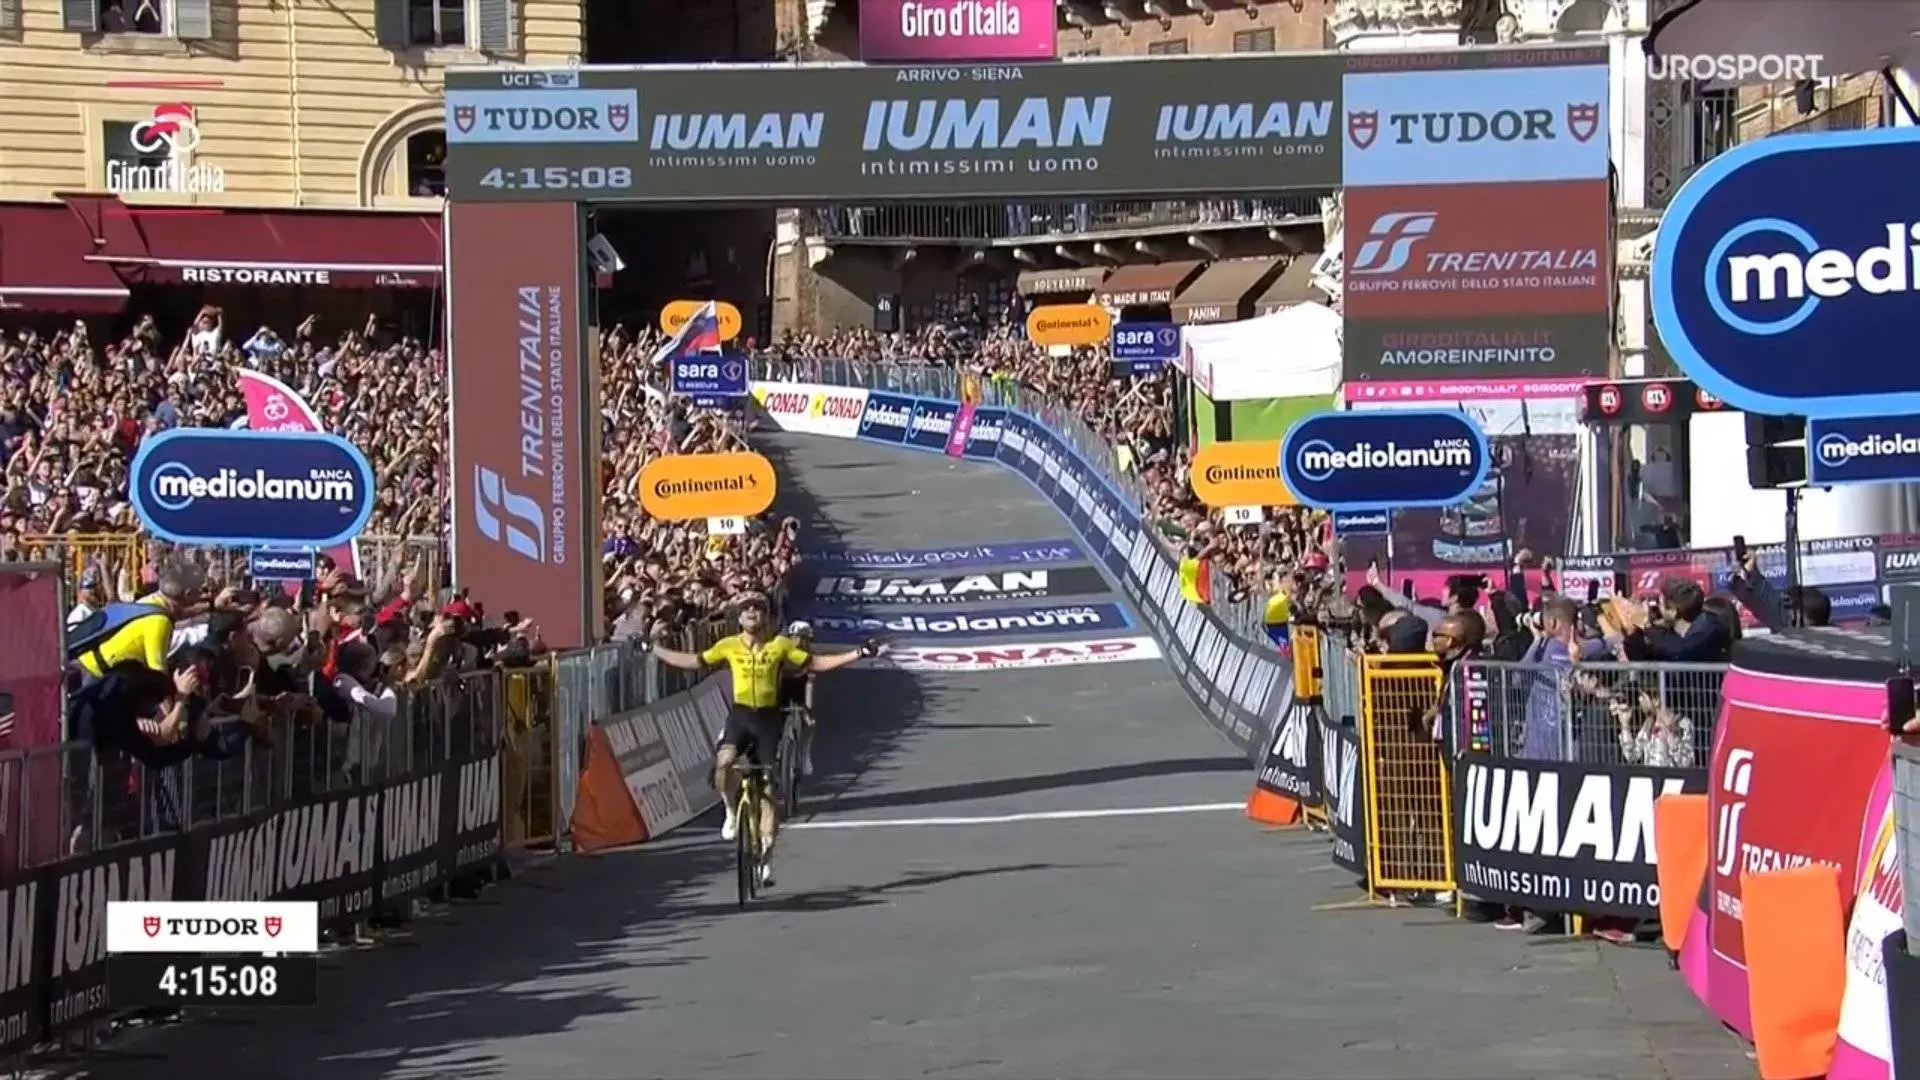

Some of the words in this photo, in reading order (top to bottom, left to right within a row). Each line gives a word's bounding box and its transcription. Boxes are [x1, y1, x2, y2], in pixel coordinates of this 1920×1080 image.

[902, 2, 946, 37] Giro
[950, 1, 1020, 36] d'Italia
[501, 73, 530, 86] UCI
[896, 68, 960, 82] ARRIVO
[971, 67, 1023, 81] SIENA
[484, 106, 601, 131] TUDOR
[862, 96, 1112, 151] IUMAN
[1154, 101, 1334, 142] IUMAN
[1390, 108, 1556, 144] TUDOR
[650, 112, 825, 150] IUMAN
[649, 154, 757, 167] intimissimi
[766, 154, 816, 166] uomo
[1154, 144, 1264, 159] intimissimi
[1272, 143, 1325, 156] uomo
[479, 166, 633, 189] 4:15:08
[860, 158, 1015, 176] intimissimi
[1027, 157, 1099, 174] uomo
[1426, 248, 1597, 273] TRENITALIA
[182, 267, 330, 285] RISTORANTE
[1349, 279, 1399, 292] GRUPPO
[1402, 277, 1457, 291] FERROVIE
[1461, 276, 1500, 290] DELLO
[1502, 276, 1540, 289] STATO
[1542, 275, 1597, 287] ITALIANE
[1113, 292, 1136, 305] MADE
[1139, 291, 1148, 304] IN
[1150, 289, 1171, 303] ITALY
[548, 286, 562, 347] ITALIANE
[1187, 306, 1221, 320] PANINI
[1036, 317, 1092, 332] Continental
[1116, 331, 1154, 345] sara
[1382, 331, 1553, 348] GIRODITALIA.IT
[1380, 347, 1556, 365] AMOREINFINITO
[518, 285, 544, 477] TRENITALIA
[550, 350, 563, 394] STATO
[677, 363, 718, 378] sara
[764, 391, 809, 413] CONAD
[823, 398, 862, 420] CONAD
[551, 395, 564, 437] DELLO
[1433, 438, 1471, 448] BANCA
[1305, 441, 1471, 470] mediolanum
[310, 470, 353, 481] BANCA
[551, 440, 565, 504] FERROVIE
[1205, 464, 1281, 484] Continent
[158, 469, 354, 501] mediolanum
[654, 475, 745, 498] Continental
[719, 519, 734, 529] 10
[1235, 510, 1250, 520] 10
[553, 507, 565, 564] GRUPPO
[1811, 537, 1874, 550] INFINITO
[814, 570, 1048, 596] IUMAN
[1563, 576, 1613, 589] COND
[814, 611, 1101, 633] mediolanum
[888, 641, 1138, 665] CONAD
[456, 758, 500, 836] IUM
[1463, 765, 1684, 865] IUMAN
[1464, 863, 1571, 899] intimissimi
[1584, 878, 1660, 906] uomo
